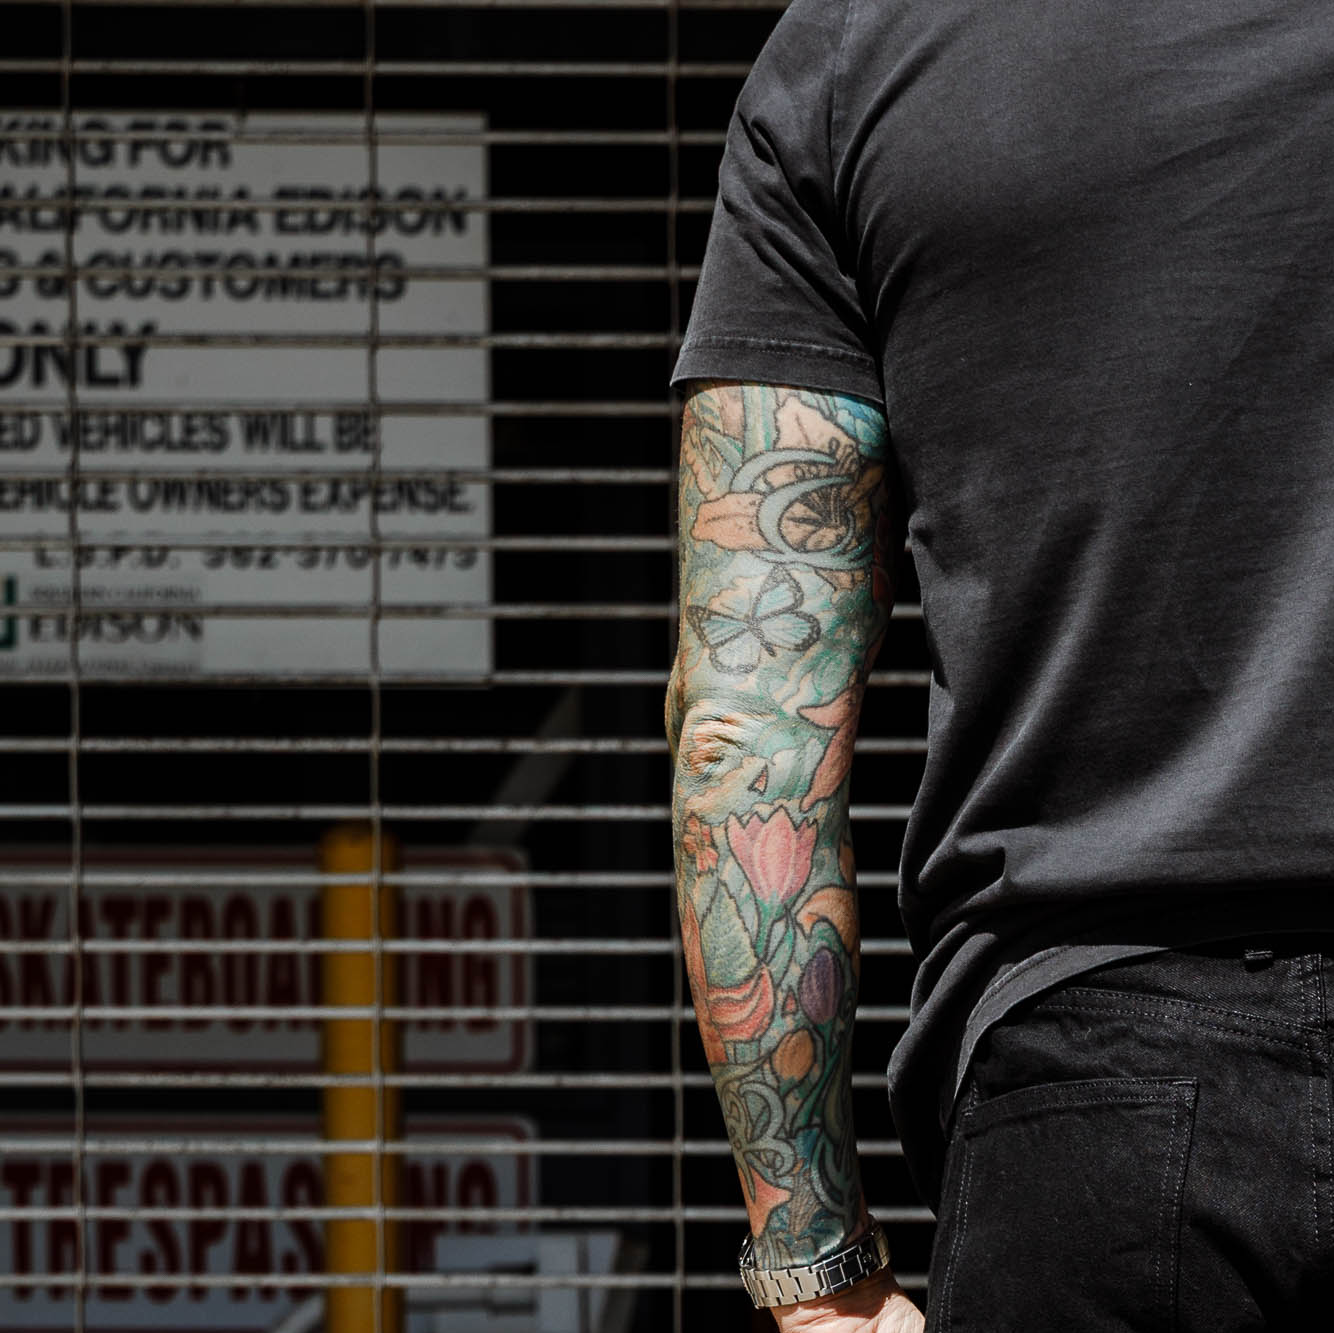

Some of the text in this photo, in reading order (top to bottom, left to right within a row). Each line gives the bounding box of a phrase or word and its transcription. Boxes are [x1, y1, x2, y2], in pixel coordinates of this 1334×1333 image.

[128, 119, 231, 168] FOR
[274, 184, 467, 237] EDISON
[84, 252, 407, 301] CUSTOMERS
[51, 408, 230, 453] VEHICLES
[240, 408, 326, 453] WILL
[332, 408, 376, 453] BE
[0, 893, 498, 1034] KATEBOANG
[2, 1160, 497, 1304] TRESPASN
